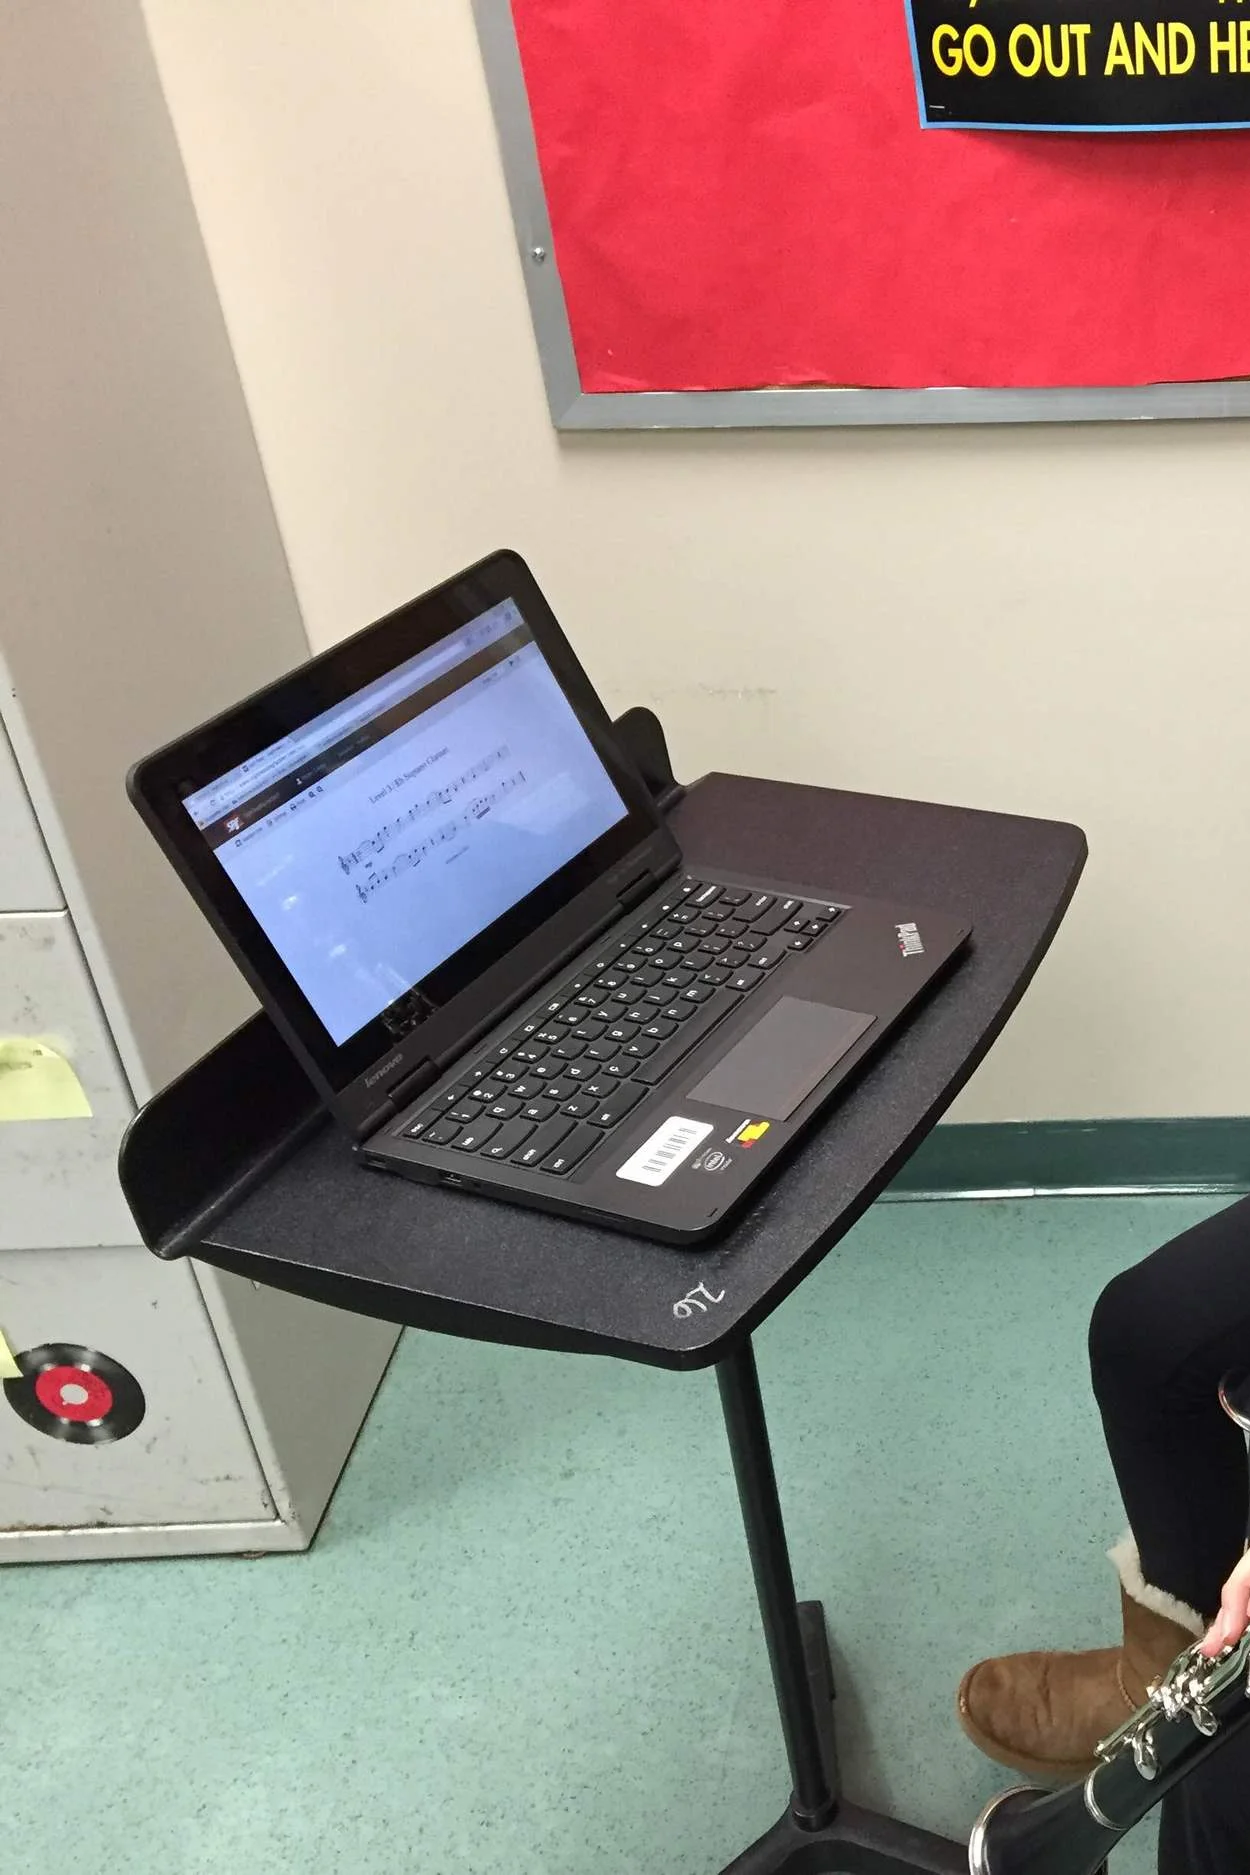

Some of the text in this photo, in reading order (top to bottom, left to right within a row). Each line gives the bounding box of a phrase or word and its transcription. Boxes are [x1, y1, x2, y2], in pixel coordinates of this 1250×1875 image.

[931, 23, 997, 77] GO
[1008, 23, 1091, 78] OUT
[1103, 22, 1196, 76] AND
[894, 922, 925, 957] ThinkPad
